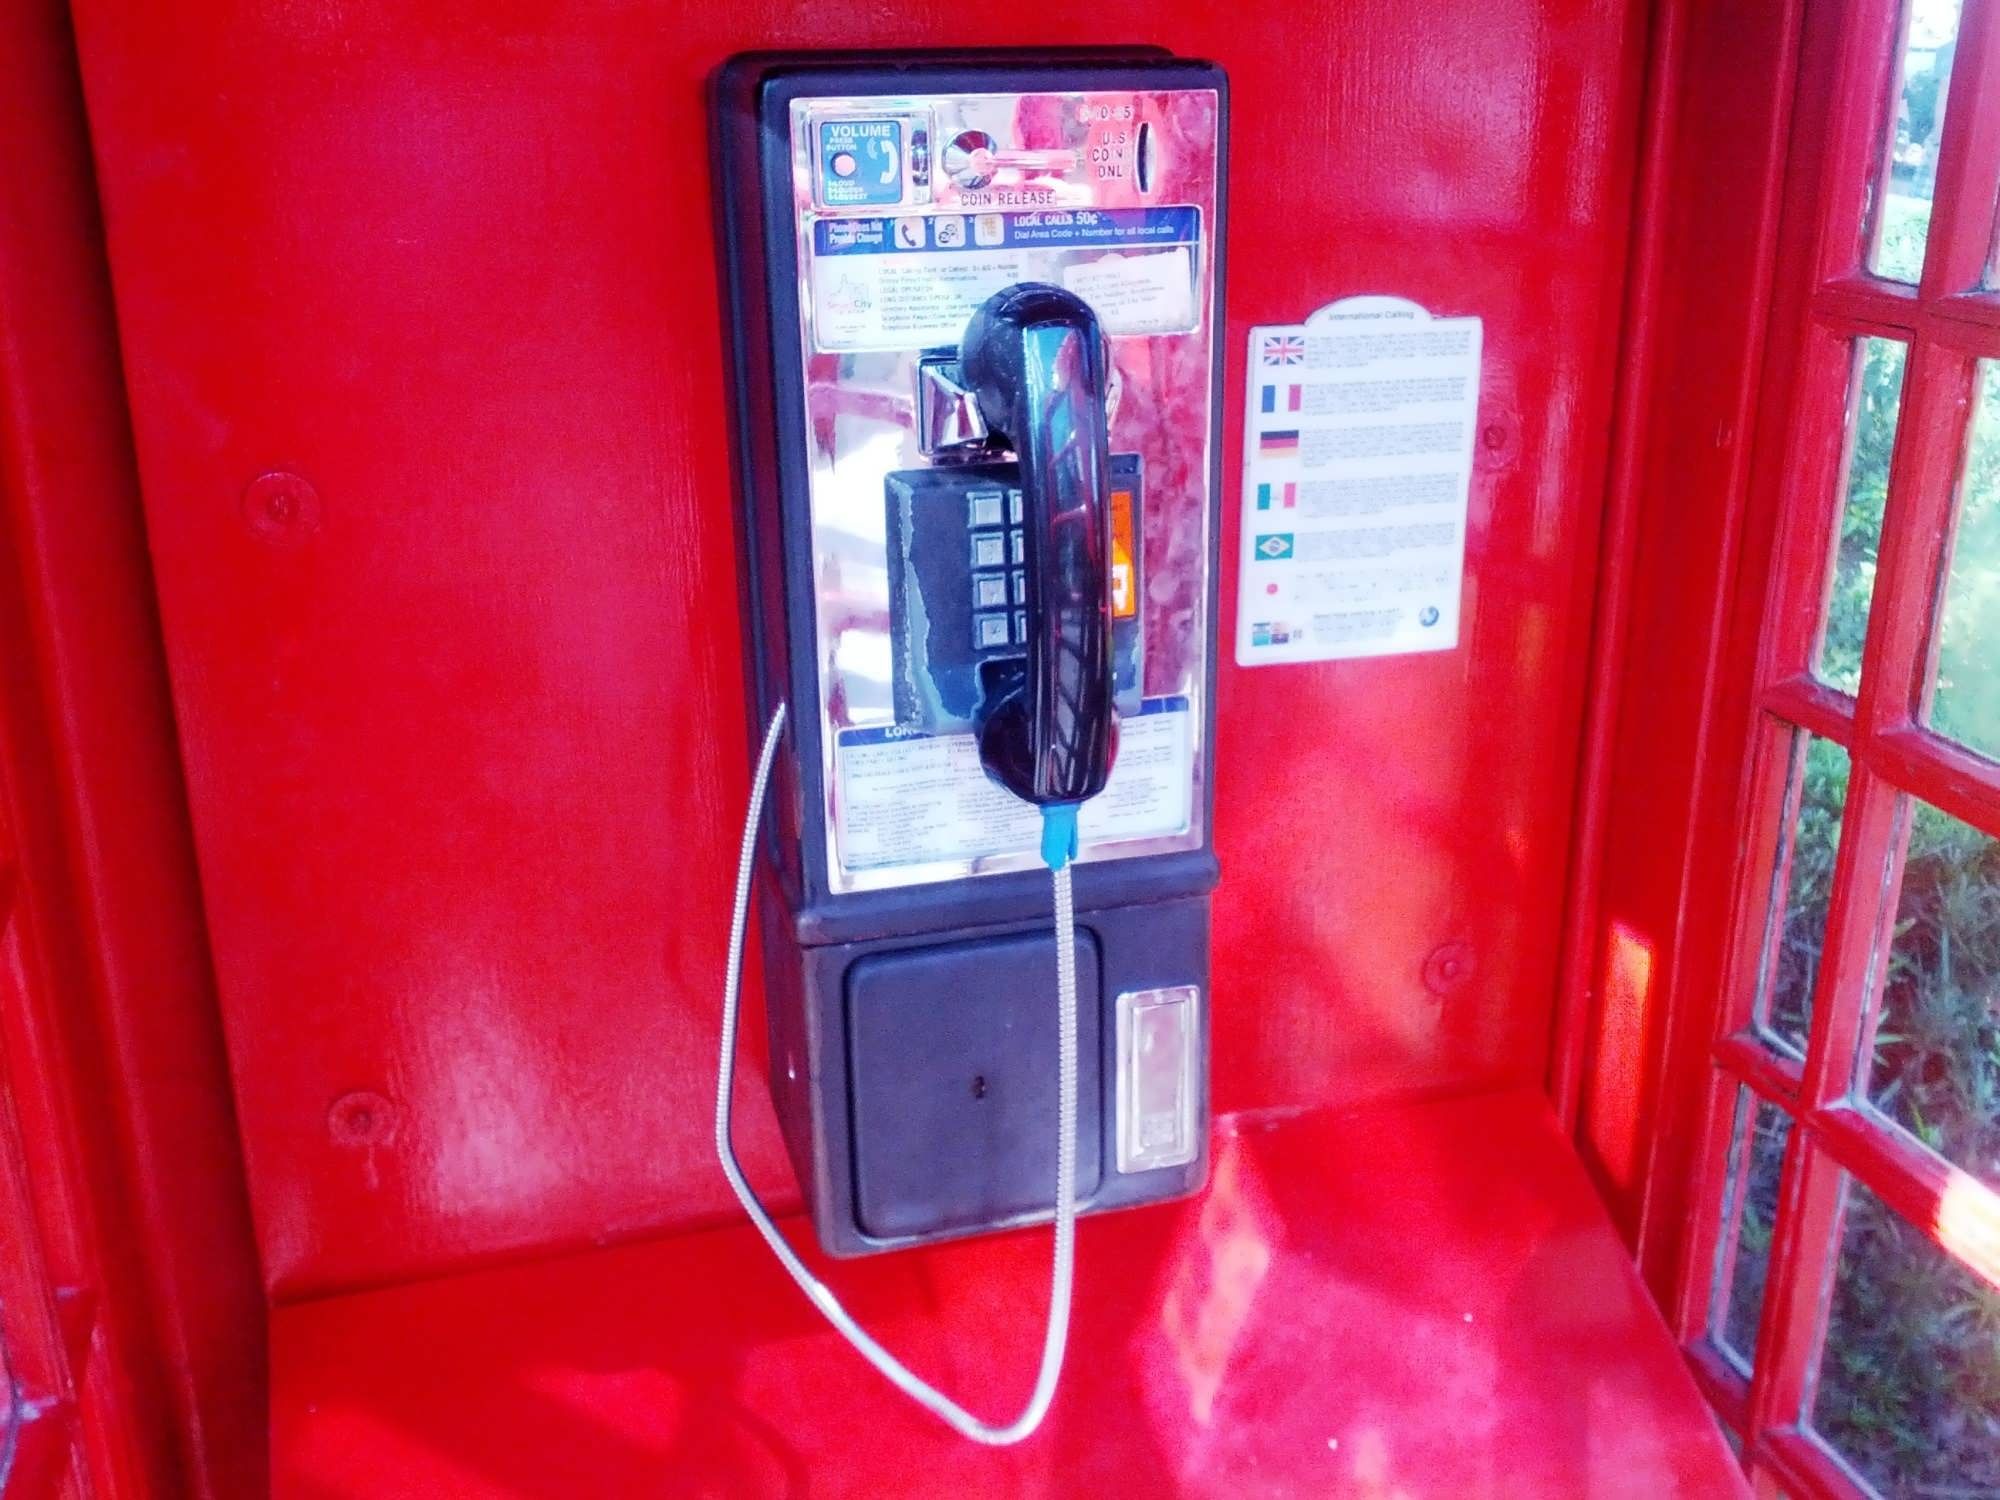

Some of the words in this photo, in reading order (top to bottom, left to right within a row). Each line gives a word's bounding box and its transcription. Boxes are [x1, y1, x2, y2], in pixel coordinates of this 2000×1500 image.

[831, 125, 891, 137] VOLUME
[961, 193, 992, 206] COIN
[998, 191, 1053, 206] RELEASE
[1014, 215, 1043, 227] LOCAL
[1045, 214, 1074, 226] CALLS
[1076, 211, 1099, 226] 50¢
[1051, 228, 1073, 238] Code
[1157, 224, 1175, 235] calls
[884, 725, 913, 738] LON
